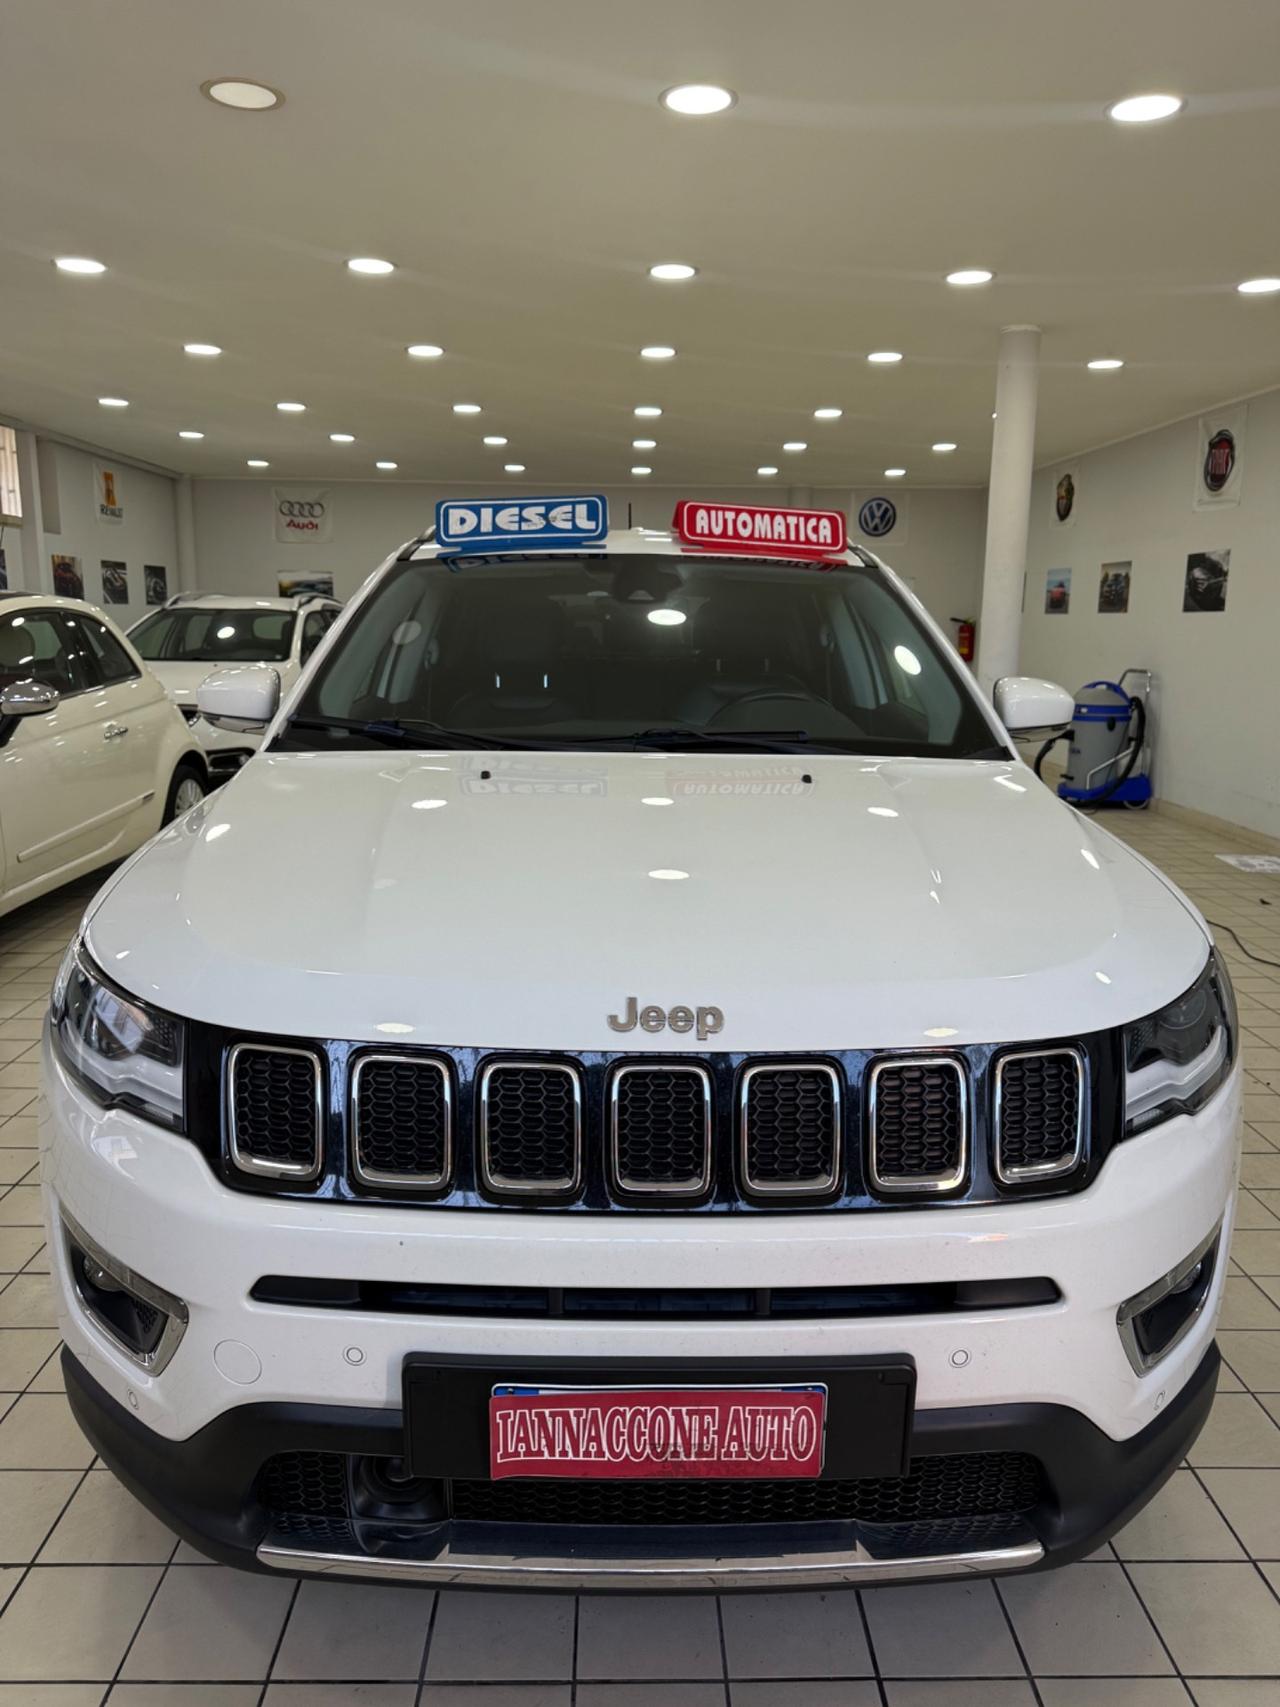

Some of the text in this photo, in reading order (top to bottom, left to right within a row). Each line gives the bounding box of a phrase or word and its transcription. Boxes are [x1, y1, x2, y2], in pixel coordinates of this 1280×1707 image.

[448, 503, 596, 535] DIESEL
[695, 508, 832, 544] AUTOMATICA
[607, 997, 725, 1041] Jeep
[496, 1405, 817, 1463] IANNACCONE AUTO
